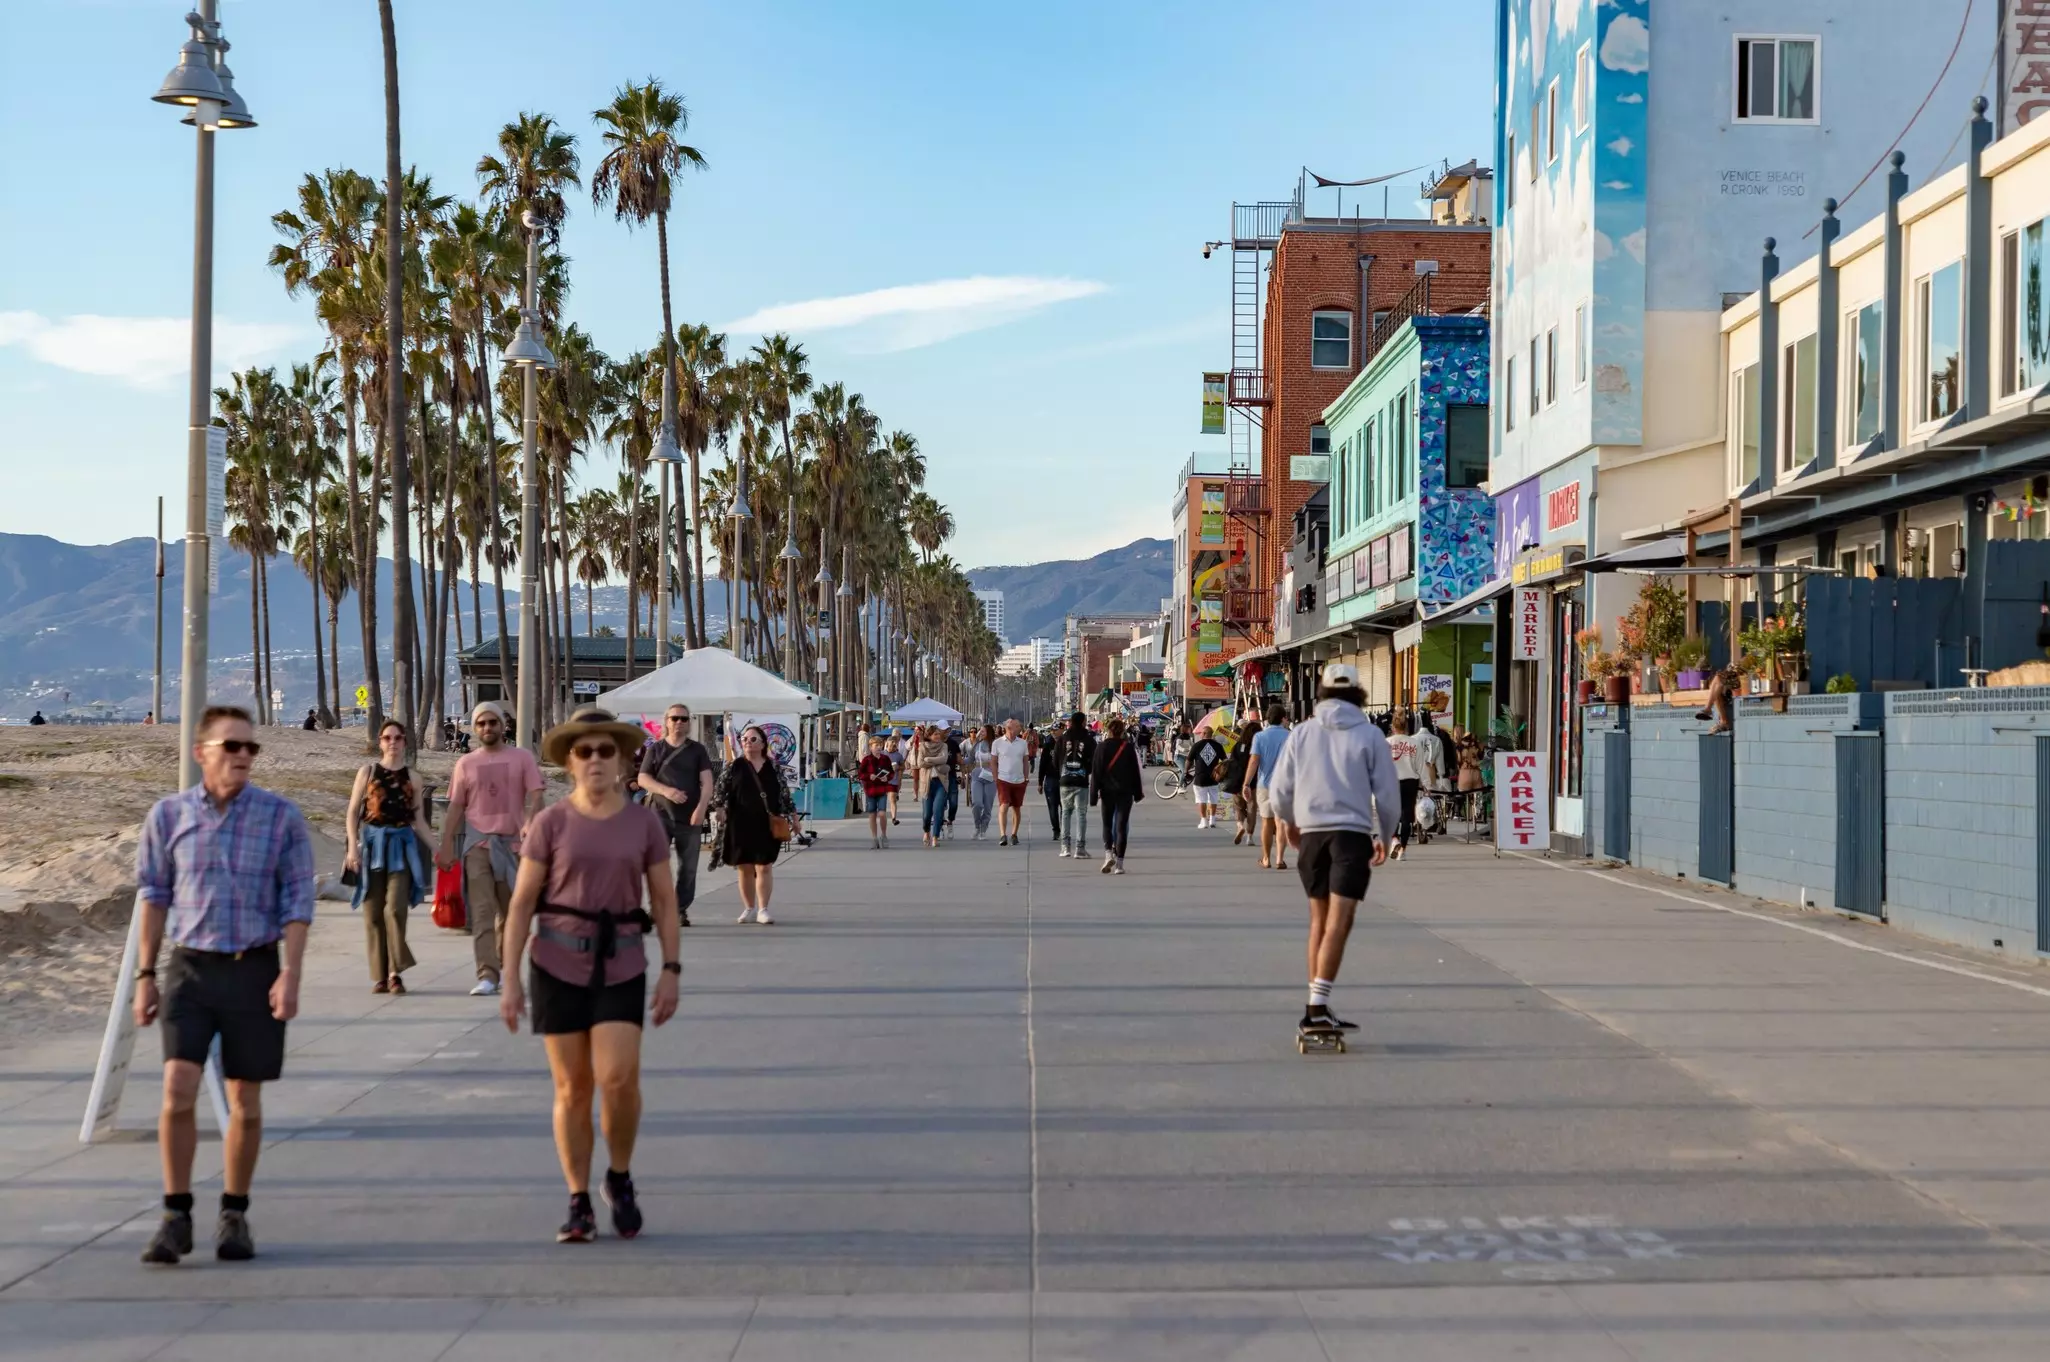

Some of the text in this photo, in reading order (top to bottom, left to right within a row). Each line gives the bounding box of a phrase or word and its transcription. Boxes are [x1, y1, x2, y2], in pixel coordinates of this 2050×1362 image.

[1720, 170, 1804, 183] VENICE BEACH
[1548, 480, 1579, 532] MARKET
[1523, 591, 1539, 657] MARKET
[1420, 675, 1438, 685] FISH
[1428, 679, 1452, 691] CHIPS
[1506, 755, 1537, 845] MARKET
